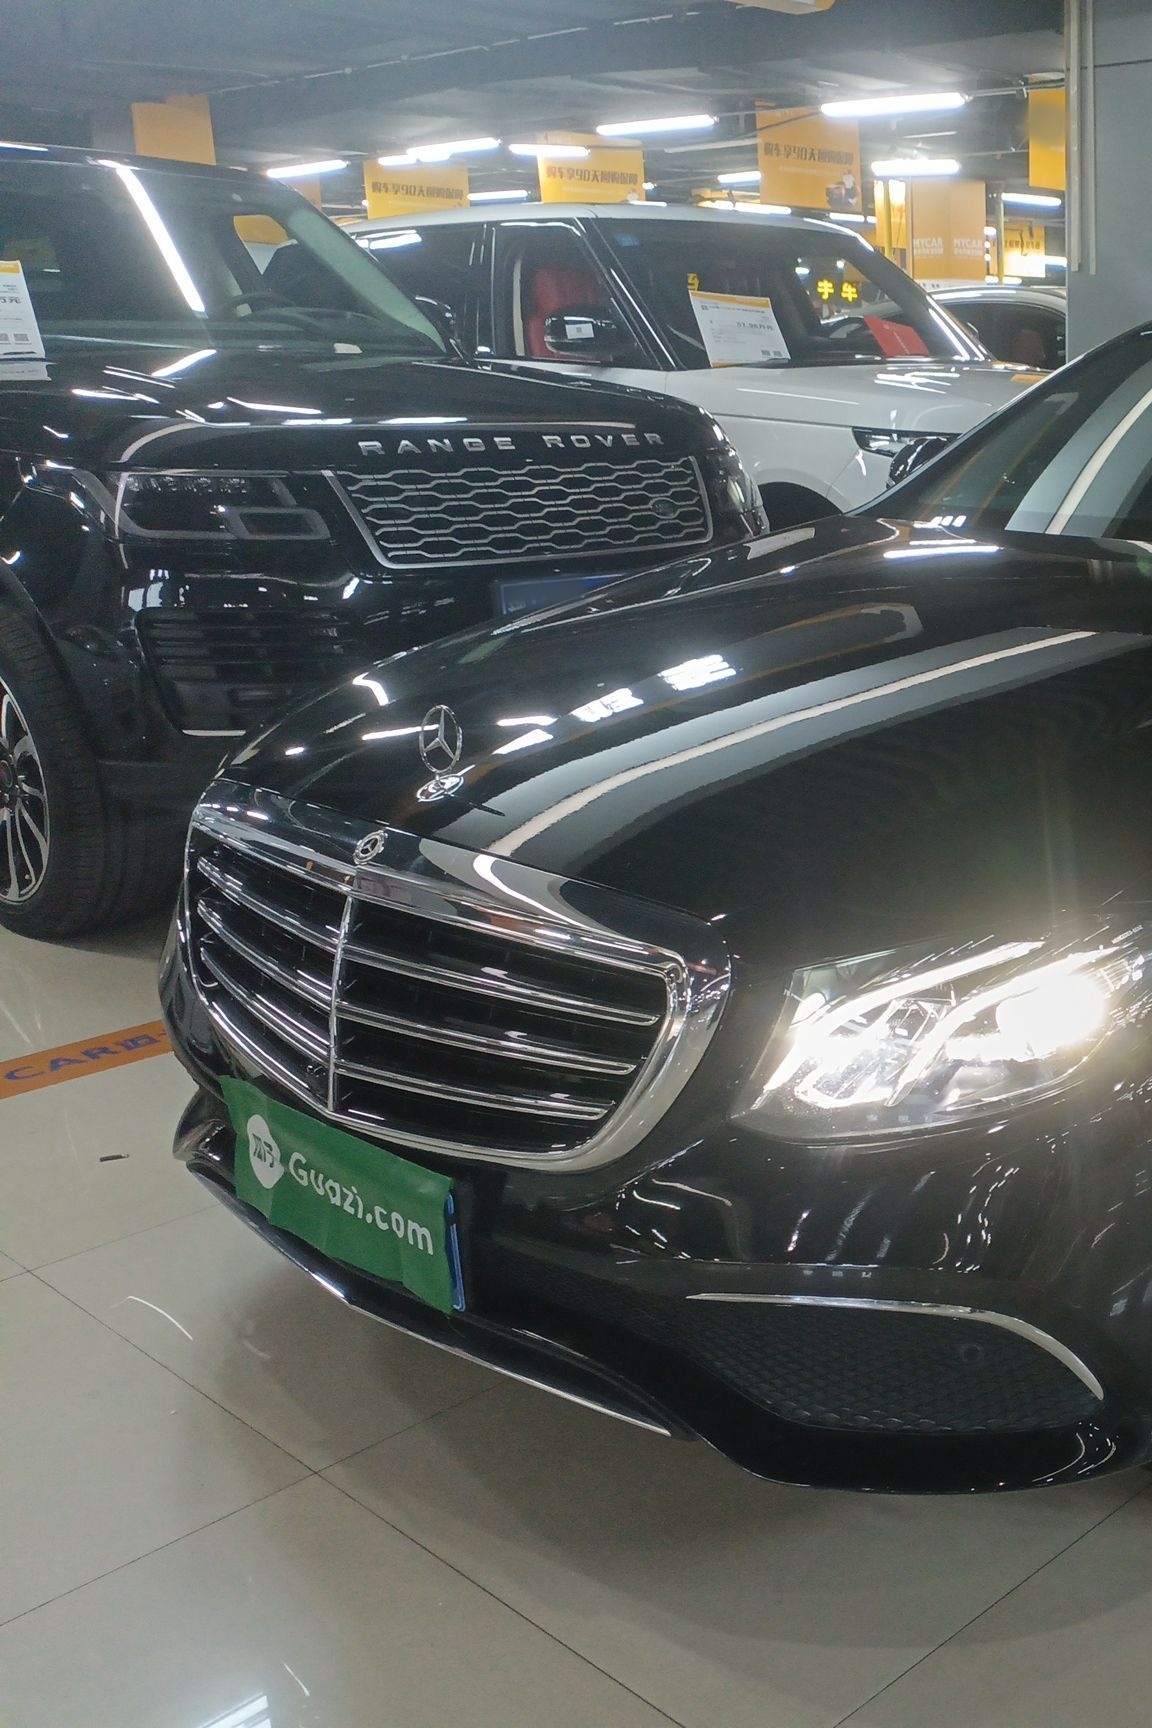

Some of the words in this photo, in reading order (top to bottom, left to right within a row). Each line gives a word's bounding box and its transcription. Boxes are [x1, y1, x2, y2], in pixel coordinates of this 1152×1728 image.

[358, 437, 516, 456] RANGE
[543, 433, 664, 449] ROVER
[288, 1151, 434, 1256] Guazi.com
